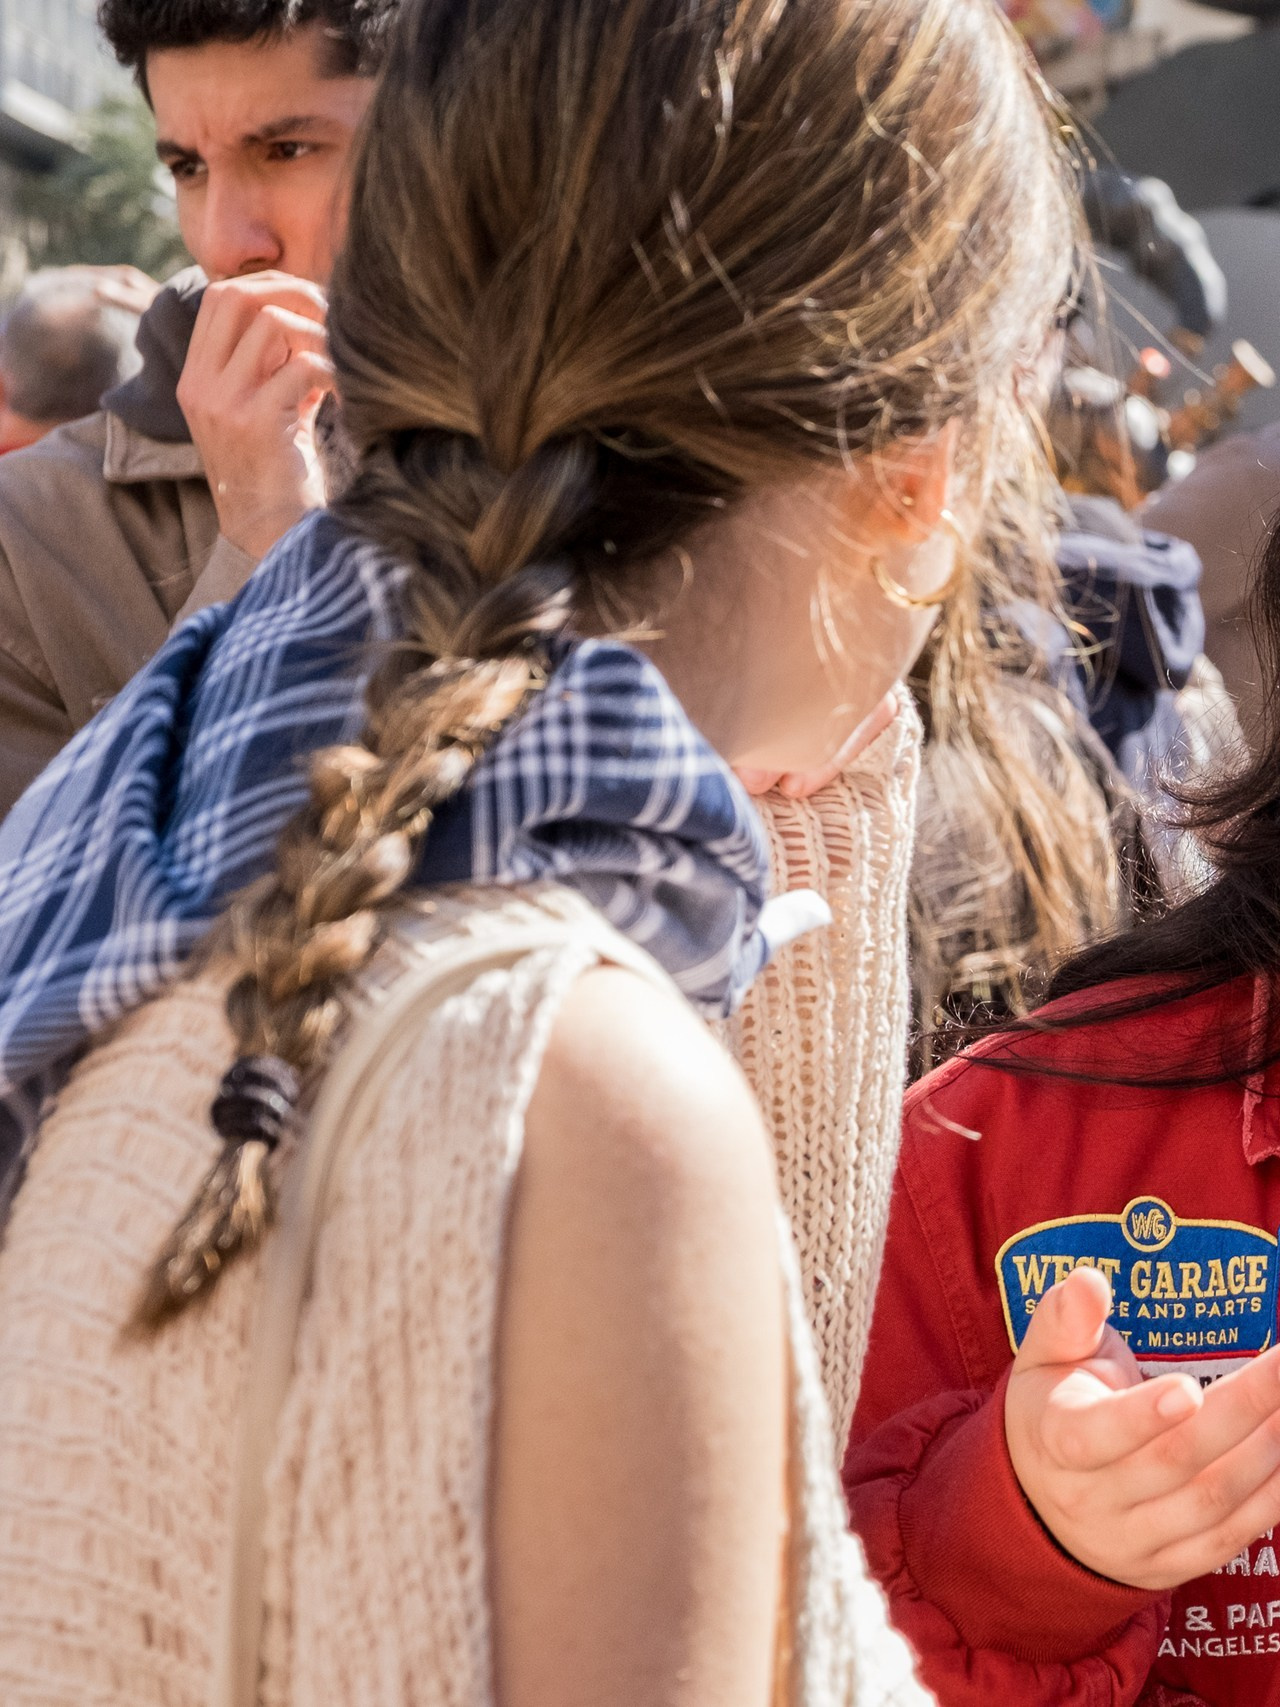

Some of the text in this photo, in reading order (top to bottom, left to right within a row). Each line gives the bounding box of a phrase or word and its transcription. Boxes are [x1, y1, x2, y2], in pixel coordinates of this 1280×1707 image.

[1131, 1209, 1167, 1240] WG
[1012, 1254, 1269, 1299] WET GARAGE
[1137, 1302, 1186, 1319] AND
[1195, 1297, 1262, 1318] PARTS
[1148, 1327, 1239, 1347] MICHIGAN
[1185, 1605, 1215, 1632] &
[1157, 1633, 1280, 1658] ANGELES
